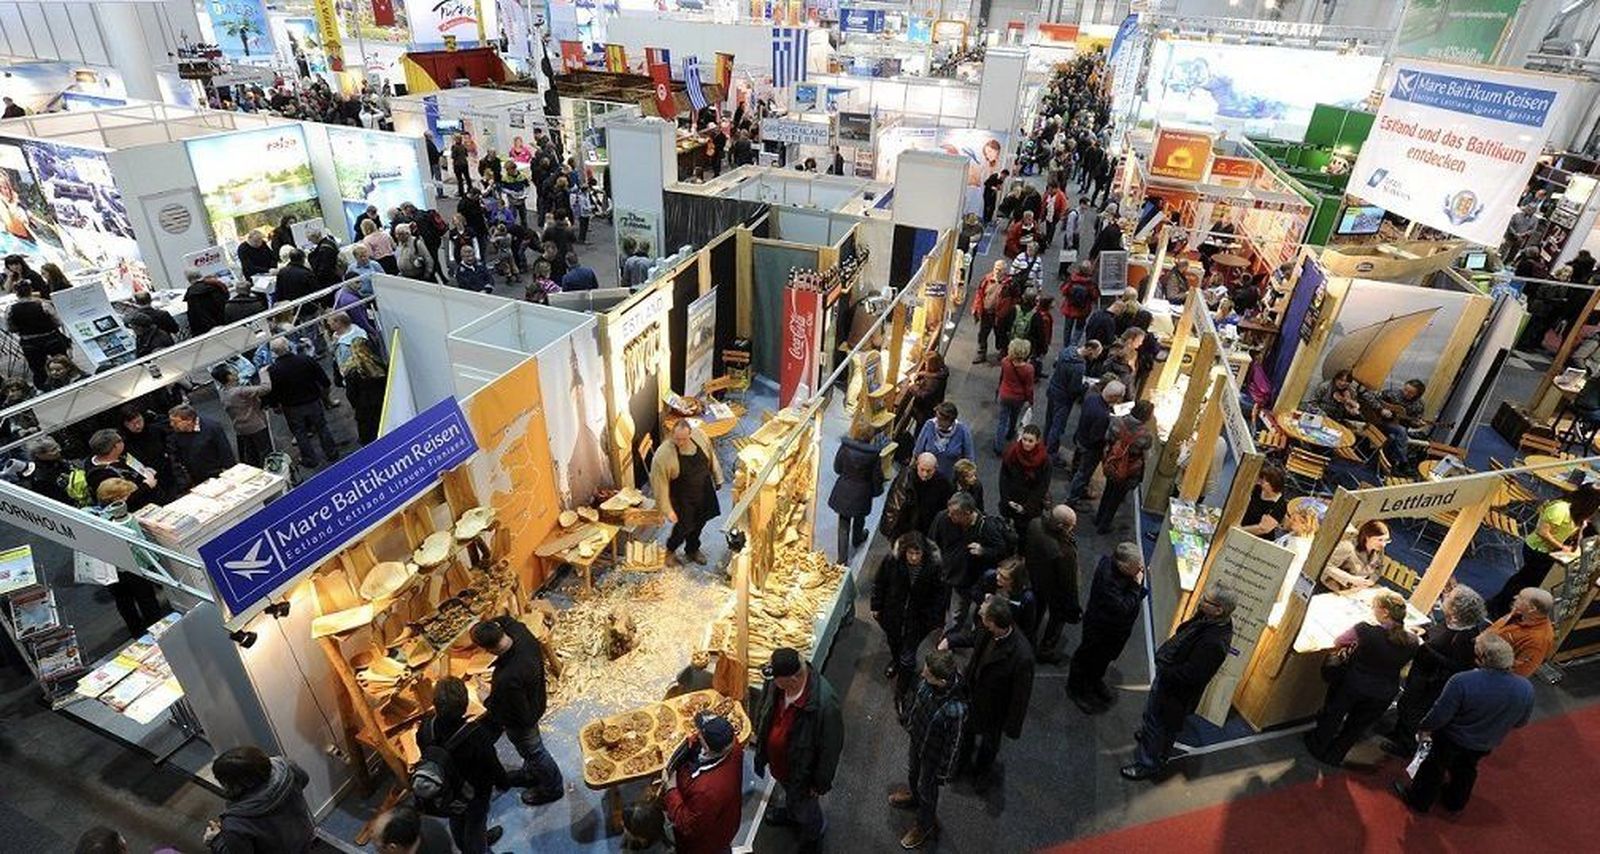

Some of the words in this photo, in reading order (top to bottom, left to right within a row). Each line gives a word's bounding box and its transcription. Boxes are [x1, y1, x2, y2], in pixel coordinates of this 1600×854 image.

[1419, 76, 1447, 93] Mare
[1446, 80, 1503, 104] Baltikum
[1502, 90, 1550, 111] Reisen
[1406, 145, 1466, 174] entdecken
[1417, 126, 1441, 145] und
[1441, 131, 1465, 150] das
[1466, 136, 1528, 166] Baltikum
[275, 503, 333, 549] Mare
[330, 454, 415, 513] Baltikum
[411, 422, 461, 460] Reisen
[1378, 489, 1459, 514] Lettland
[0, 501, 77, 541] ORNHOLM
[285, 524, 334, 560] Estland
[338, 492, 386, 528] Lettland
[387, 465, 427, 493] Litauen
